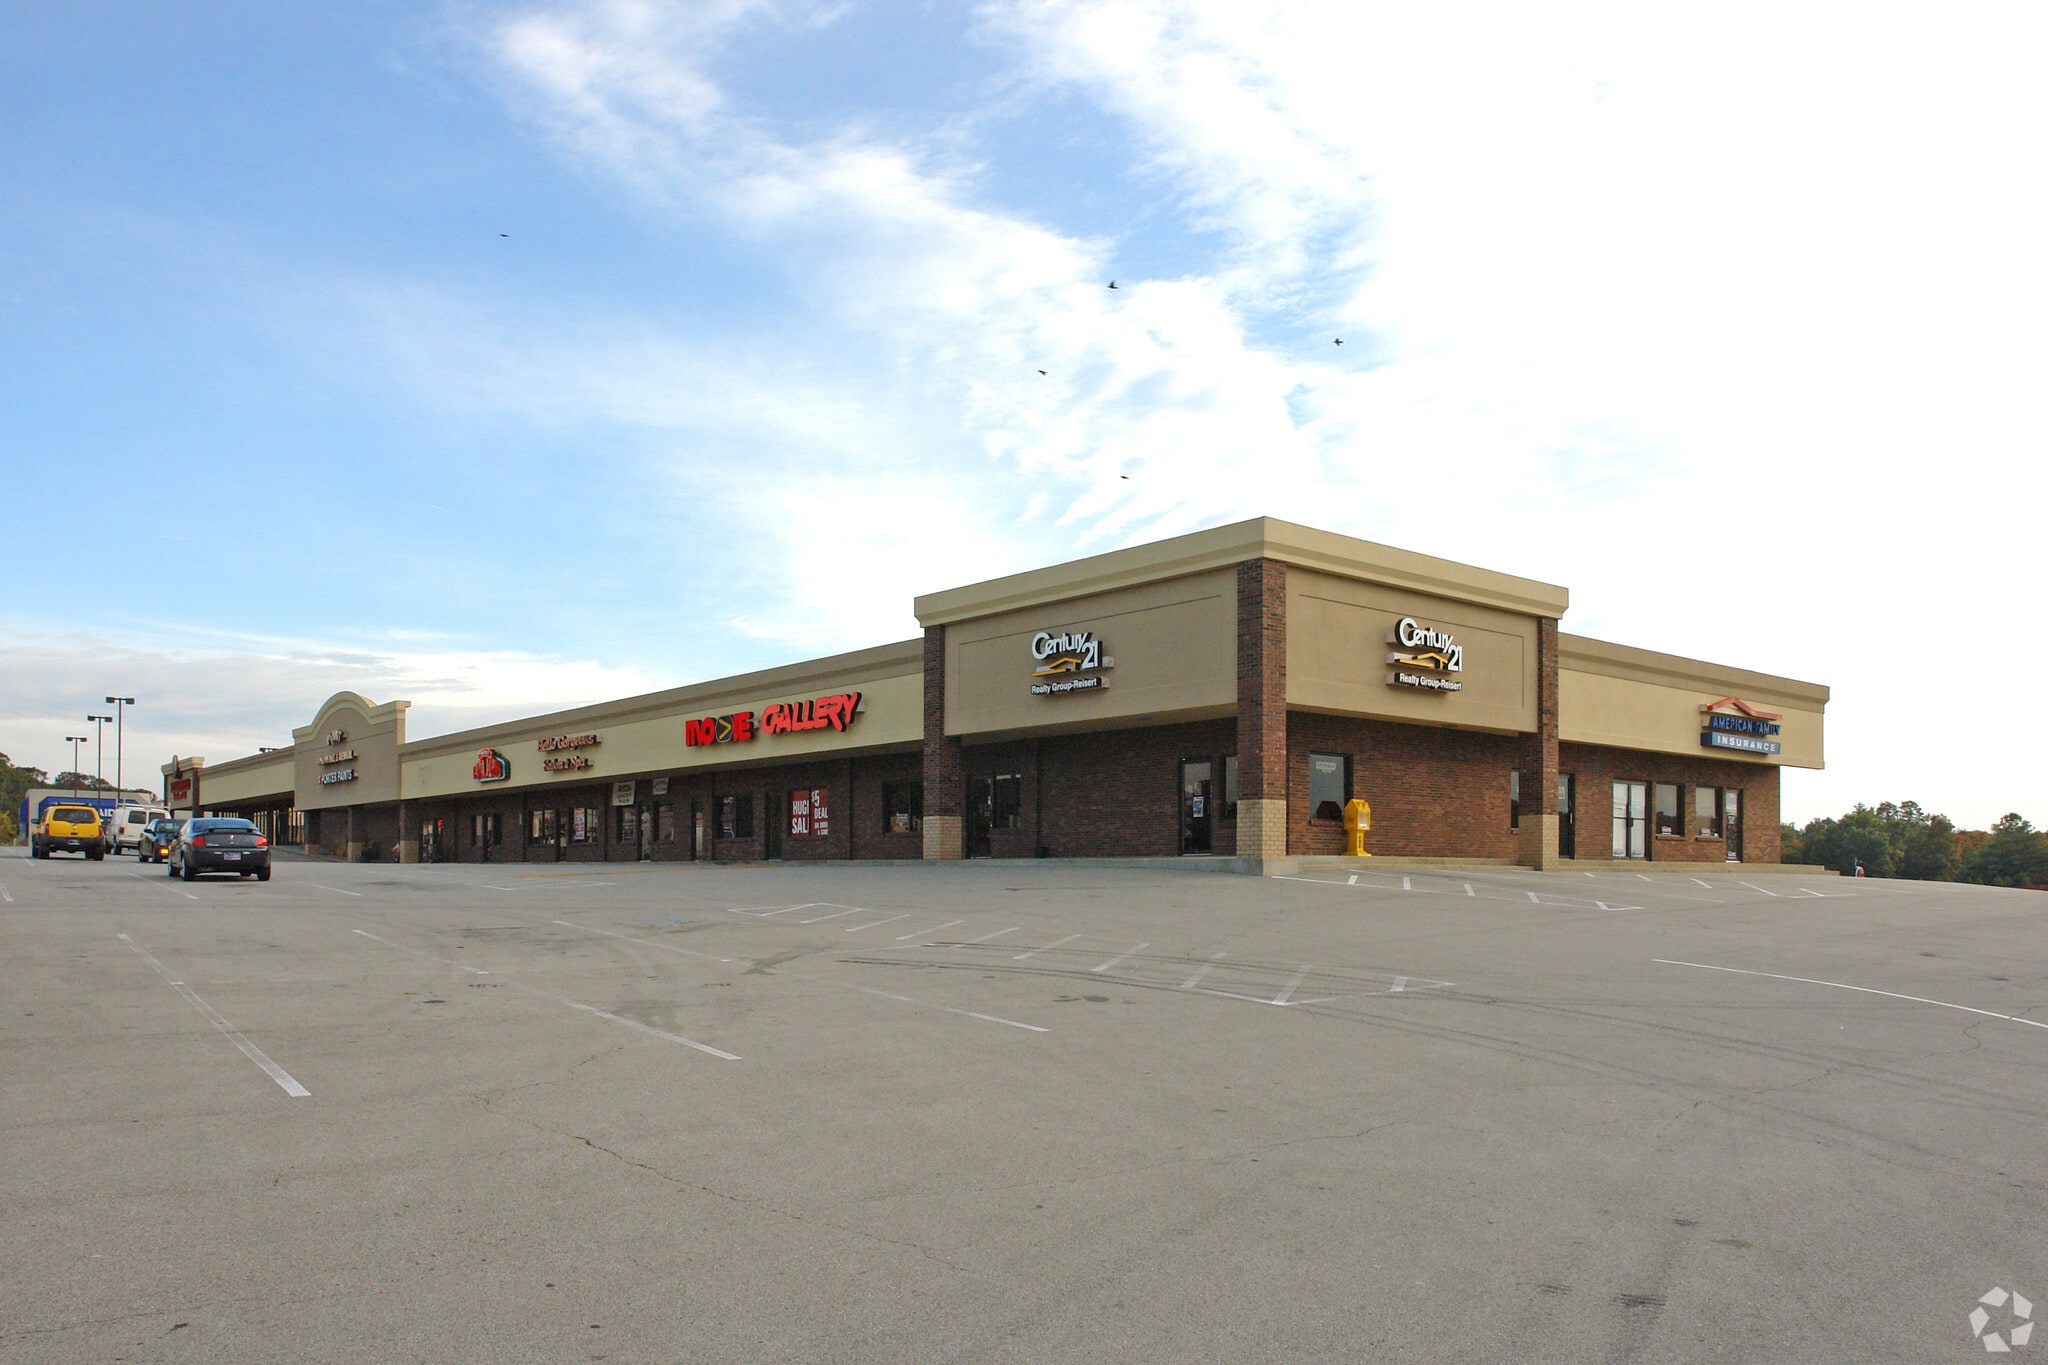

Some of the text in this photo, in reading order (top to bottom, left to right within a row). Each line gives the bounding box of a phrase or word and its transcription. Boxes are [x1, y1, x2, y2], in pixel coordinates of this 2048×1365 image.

[1032, 632, 1089, 660] Century
[1399, 617, 1454, 654] Century
[1081, 640, 1099, 670] 21
[1447, 644, 1462, 672] 21
[1031, 683, 1051, 695] Realty
[1399, 673, 1420, 686] Realty
[761, 692, 859, 734] GALLERY
[1712, 716, 1781, 736] AMERICAN FAMILY
[1717, 735, 1777, 752] INSURANCE
[814, 807, 829, 819] DEAL
